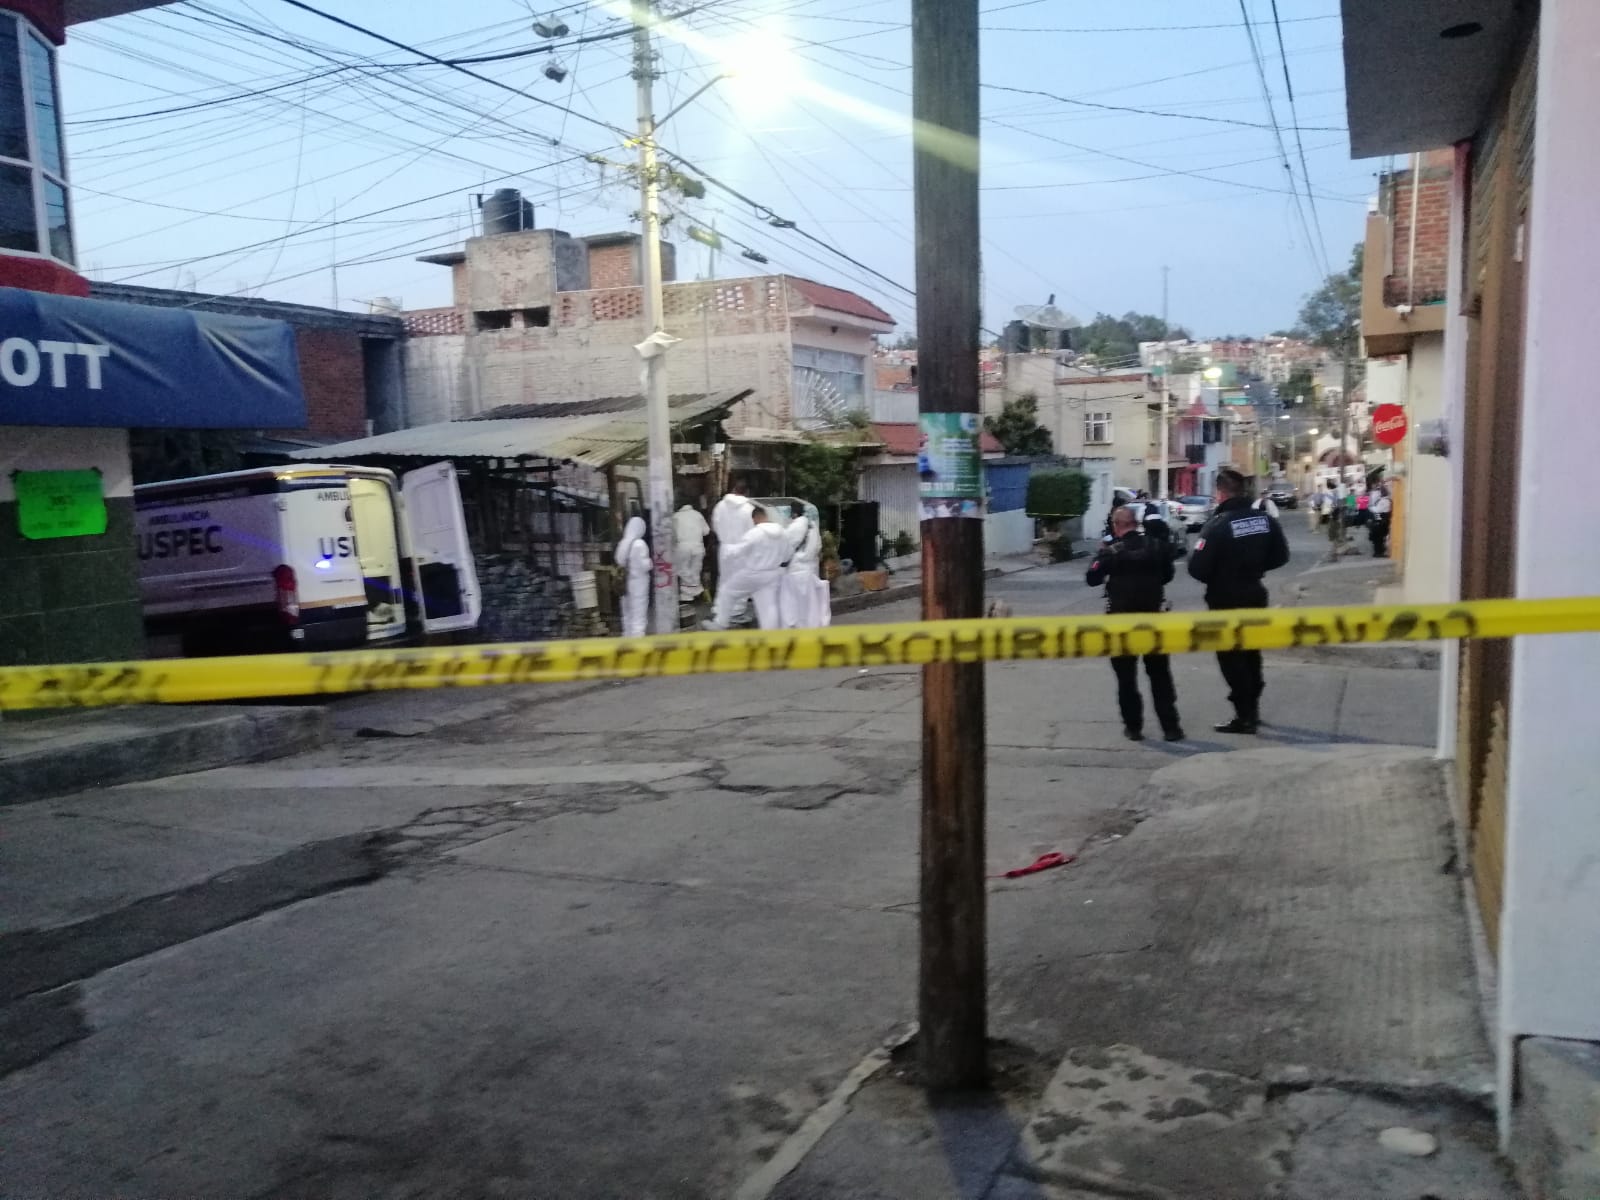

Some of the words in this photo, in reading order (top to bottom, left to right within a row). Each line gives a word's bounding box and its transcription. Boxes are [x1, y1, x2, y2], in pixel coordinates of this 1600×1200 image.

[0, 337, 110, 390] OTT
[137, 526, 223, 560] USPEC
[319, 536, 359, 560] US
